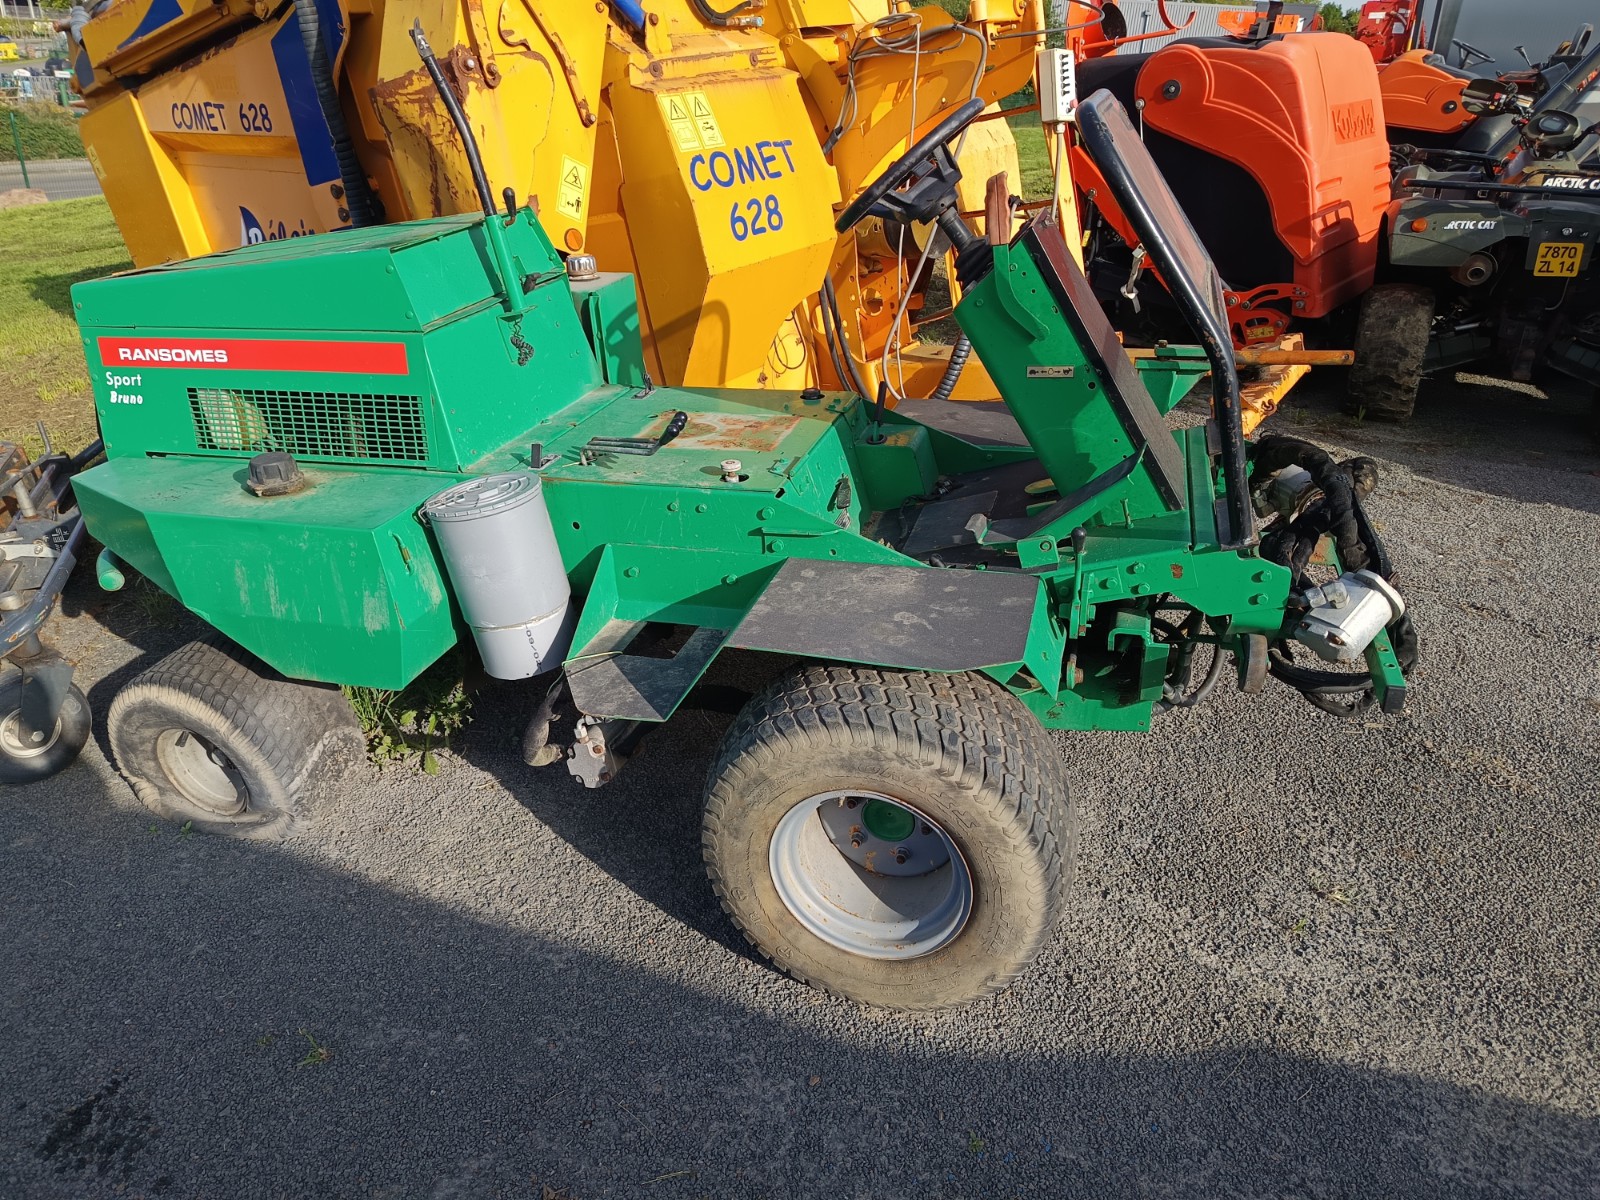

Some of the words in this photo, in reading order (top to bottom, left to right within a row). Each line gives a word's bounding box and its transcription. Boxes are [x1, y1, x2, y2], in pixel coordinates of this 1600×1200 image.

[171, 101, 226, 132] COMET
[239, 102, 273, 133] 628
[689, 139, 795, 192] COMET
[1543, 177, 1590, 190] ARCTIC
[1589, 179, 1600, 190] C
[730, 193, 784, 242] 628
[1477, 220, 1498, 230] CAT
[1541, 246, 1578, 259] 7870
[1537, 260, 1555, 273] ZL
[1559, 260, 1575, 274] 14
[118, 347, 229, 363] RANSOMES
[105, 371, 143, 389] Sport
[110, 390, 144, 405] Bruno
